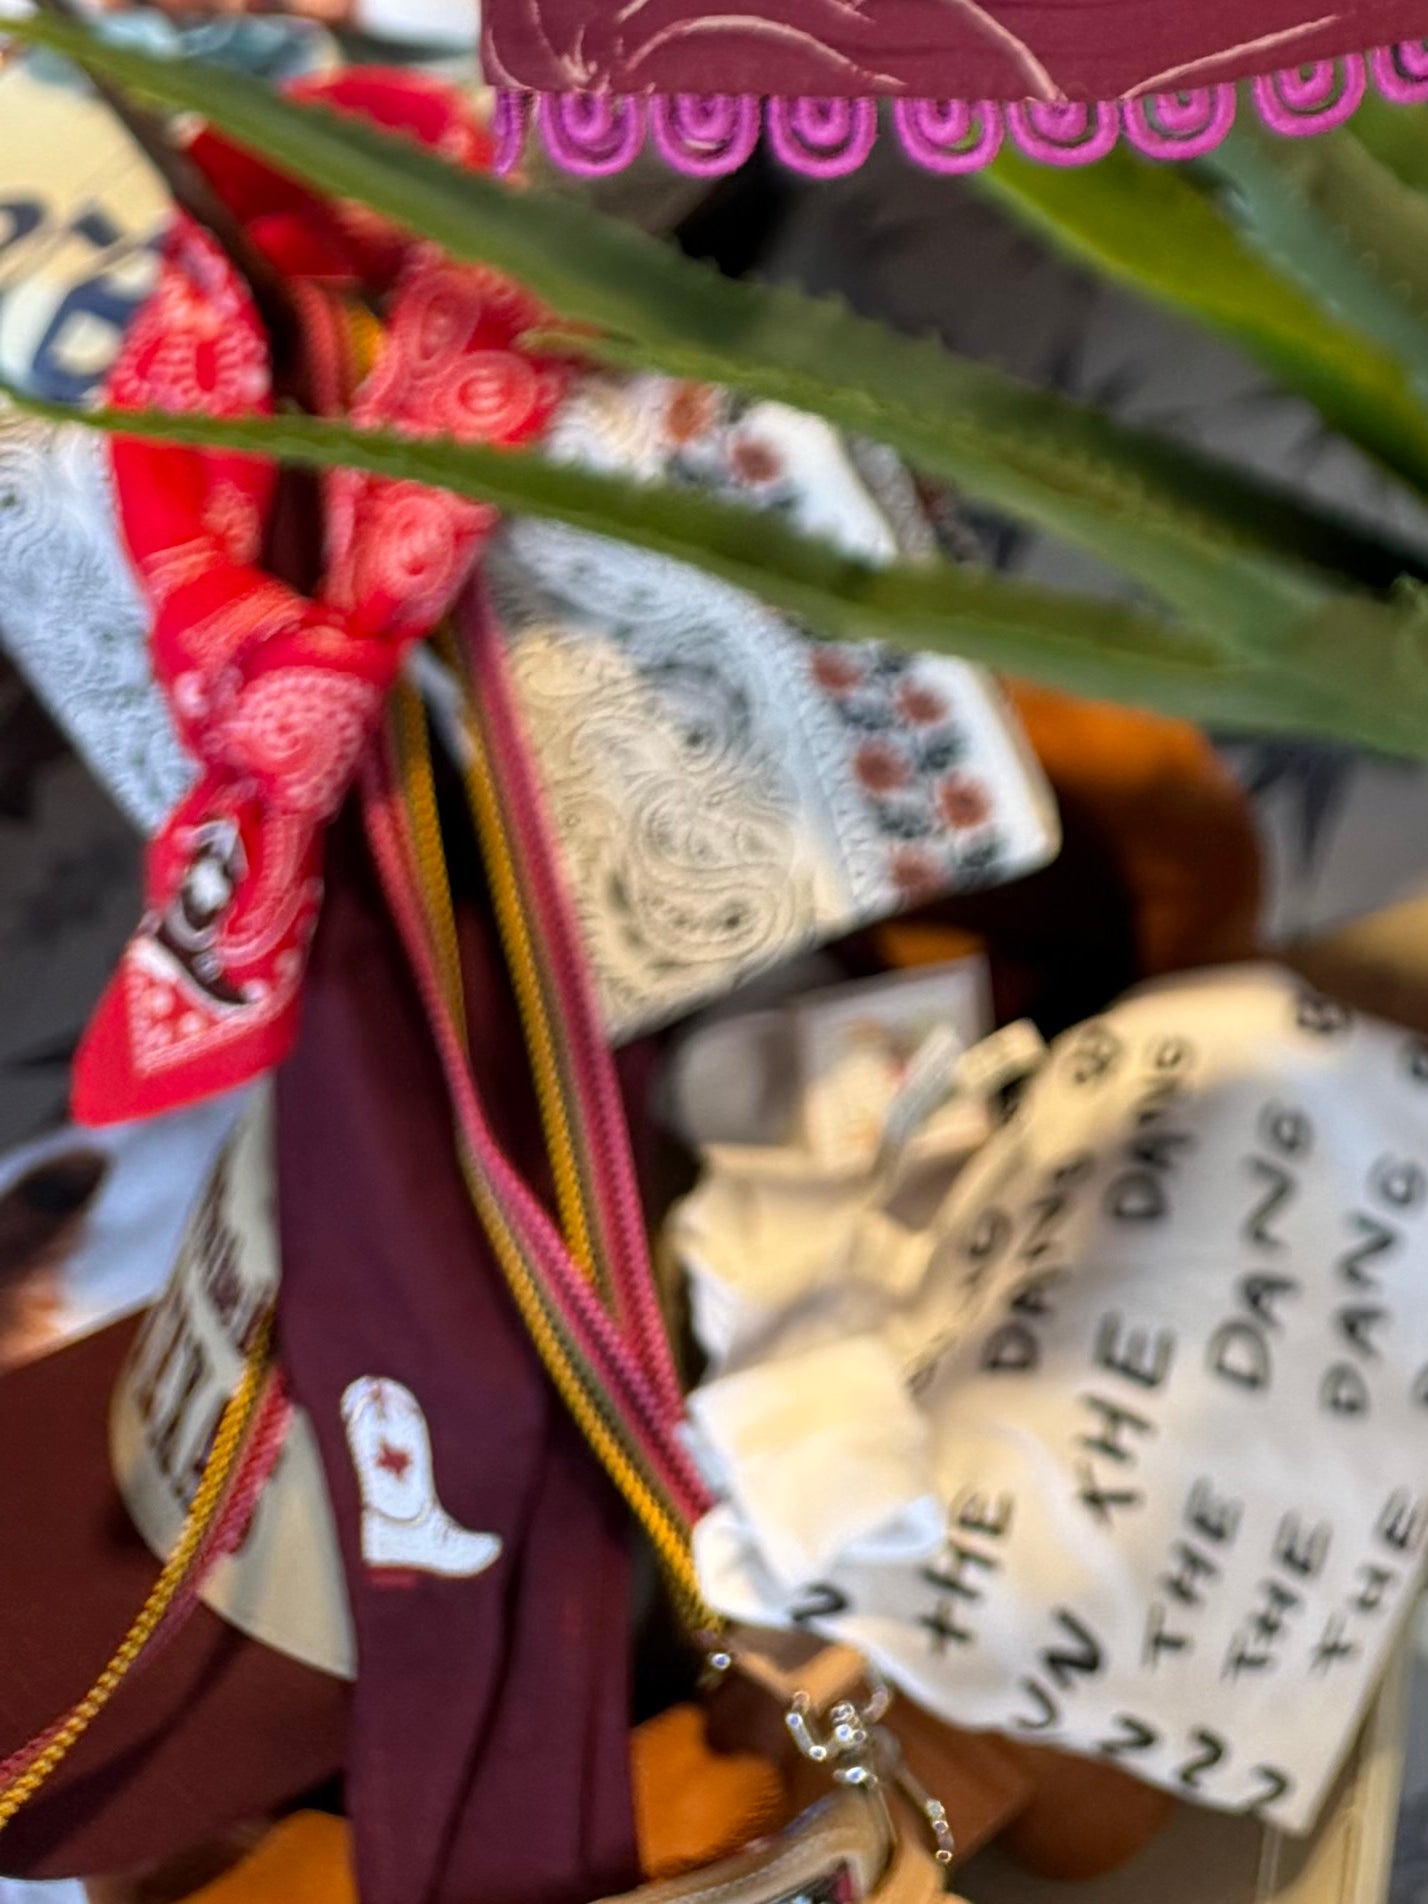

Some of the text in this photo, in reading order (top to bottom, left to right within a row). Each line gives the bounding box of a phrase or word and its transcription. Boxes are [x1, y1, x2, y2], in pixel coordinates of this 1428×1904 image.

[918, 1484, 1015, 1656] THE
[1080, 1312, 1176, 1524] THE
[1143, 1479, 1243, 1670] THE
[1212, 1101, 1312, 1392] DANG
[1221, 1513, 1336, 1683] THE
[1322, 1154, 1425, 1416] DANG
